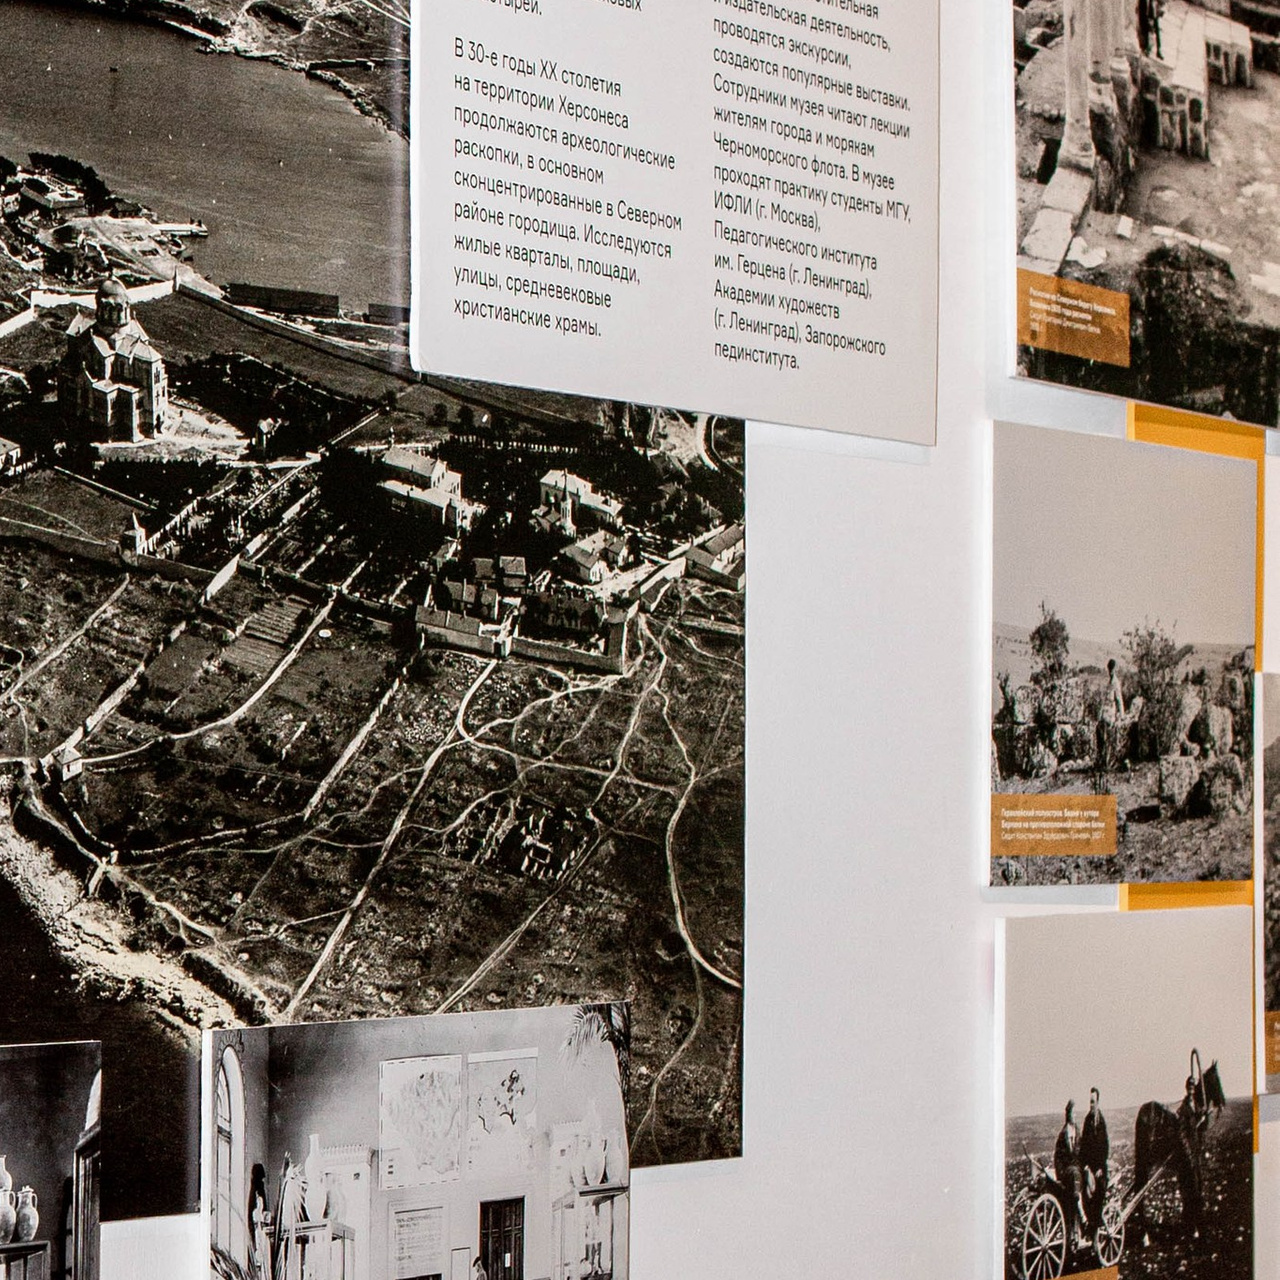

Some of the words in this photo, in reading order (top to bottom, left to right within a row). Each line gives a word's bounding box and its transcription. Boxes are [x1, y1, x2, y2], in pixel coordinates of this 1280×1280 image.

[713, 17, 786, 51] проводятся
[788, 38, 852, 70] экскурсии,
[809, 15, 891, 53] деятельность,
[454, 73, 471, 93] на
[473, 78, 555, 113] территории
[558, 93, 629, 130] Херсонеса
[713, 47, 779, 78] создаются
[781, 65, 854, 97] популярные
[855, 84, 911, 112] выставки.
[713, 72, 787, 109] Сотрудники
[790, 95, 825, 118] музея
[826, 105, 869, 129] читают
[869, 116, 910, 139] лекции
[454, 105, 558, 145] продолжаются
[561, 131, 676, 170] археологические
[454, 137, 523, 170] раскопки,
[526, 154, 535, 170] в
[537, 156, 604, 185] основном
[454, 170, 603, 216] сконцентрированные
[606, 201, 614, 218] в
[617, 199, 682, 232] Северном
[454, 199, 505, 227] районе
[508, 212, 580, 244] городища.
[583, 222, 672, 260] Исследуются
[714, 219, 819, 259] Педагогического
[820, 245, 878, 273] института
[453, 234, 502, 258] жилые
[505, 243, 573, 274] кварталы,
[576, 257, 641, 286] площади,
[453, 265, 502, 293] улицы,
[505, 275, 612, 309] средневековые
[713, 278, 776, 309] Академии
[777, 294, 840, 320] художеств
[453, 297, 552, 329] христианские
[554, 314, 602, 337] храмы.
[713, 306, 726, 331] (г.
[728, 310, 802, 344] Ленинград),
[804, 323, 887, 357] Запорожского
[714, 342, 800, 372] пединститута.
